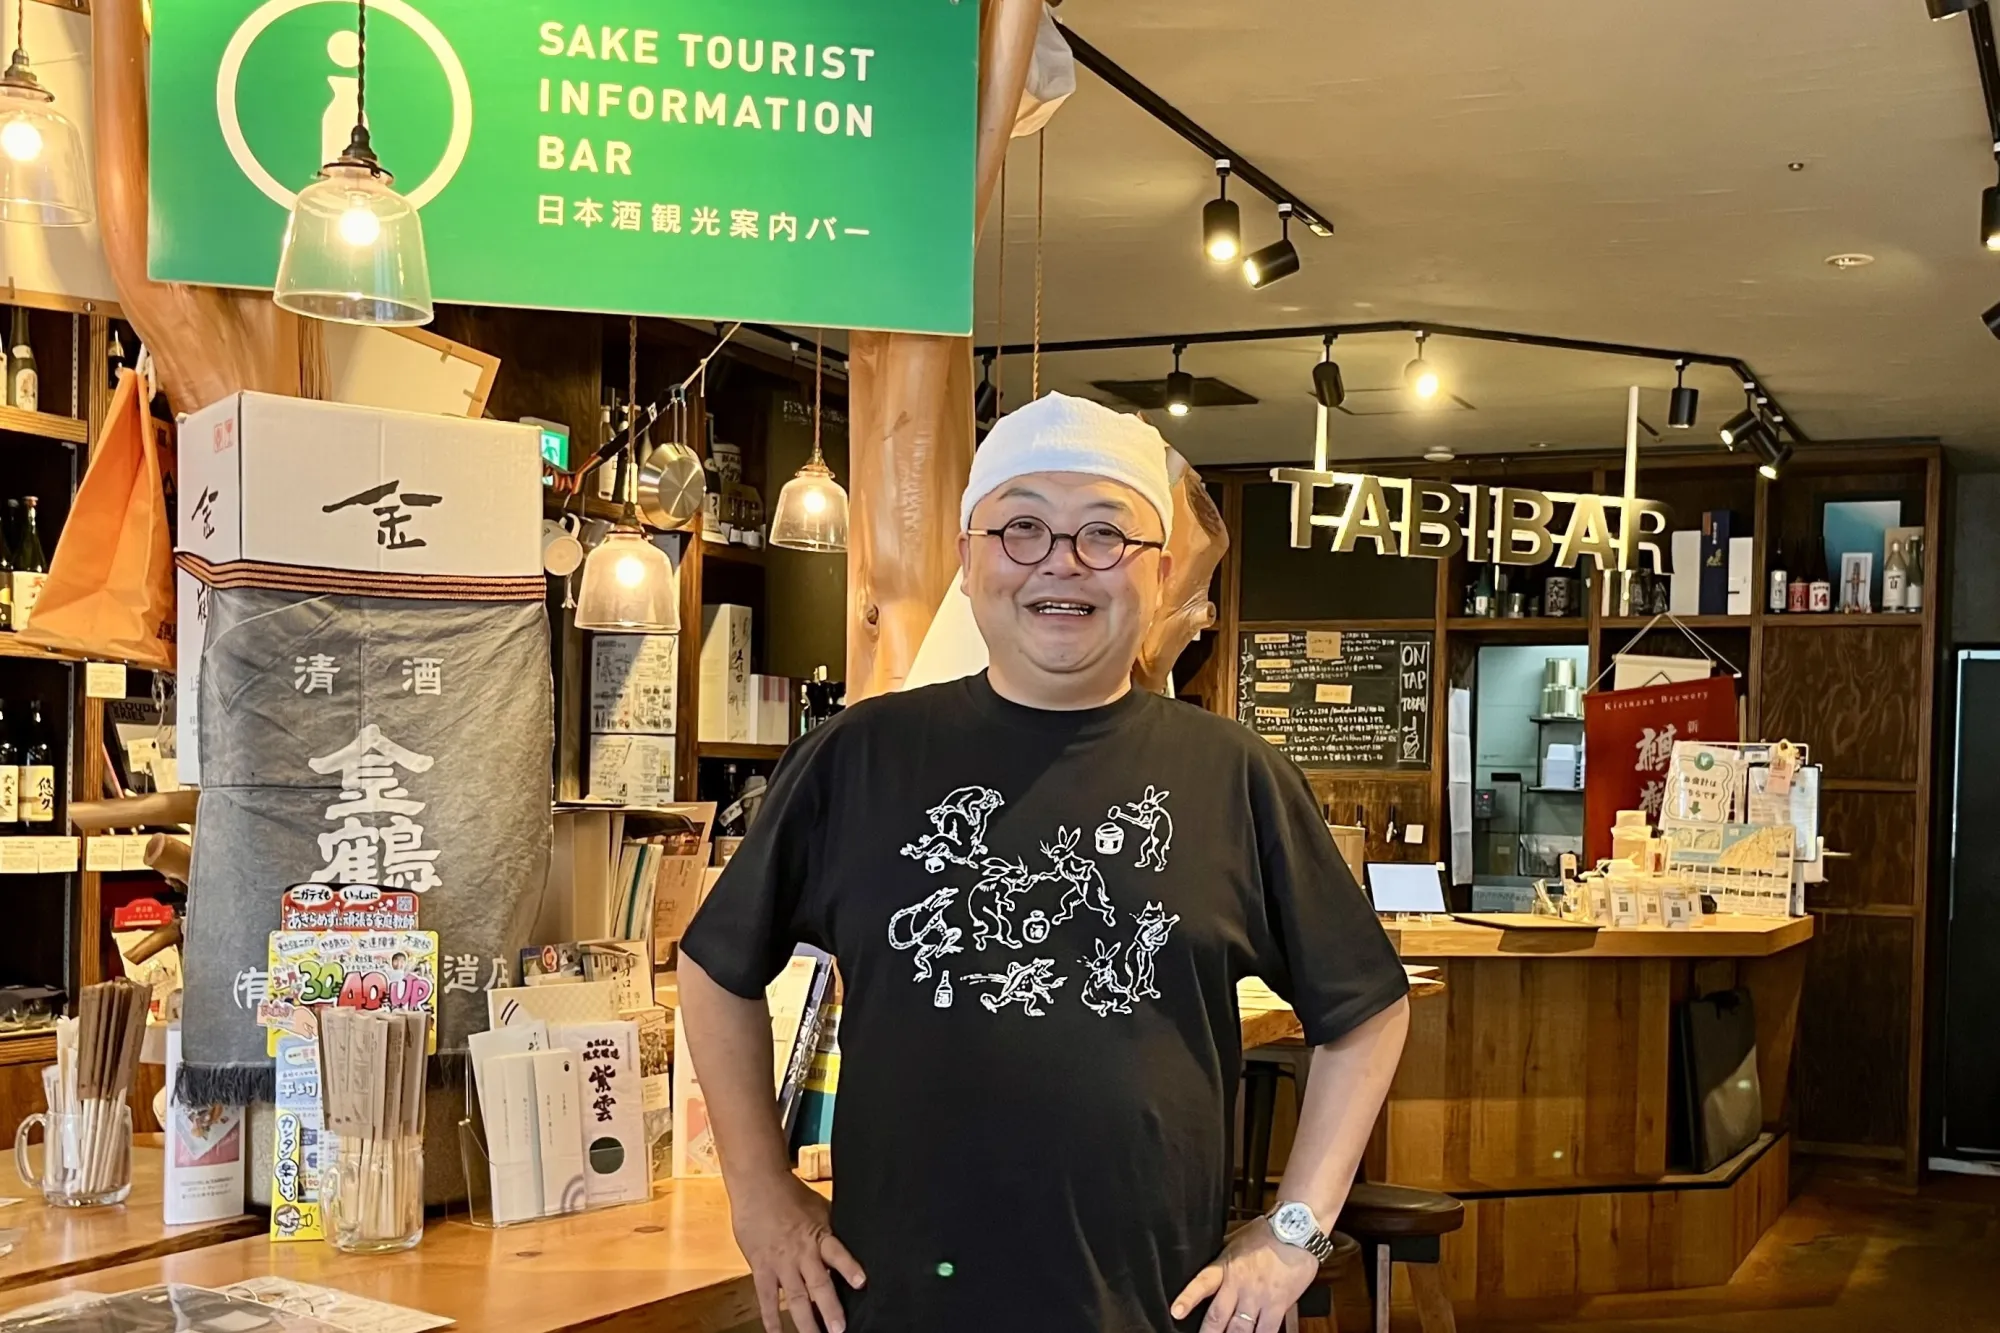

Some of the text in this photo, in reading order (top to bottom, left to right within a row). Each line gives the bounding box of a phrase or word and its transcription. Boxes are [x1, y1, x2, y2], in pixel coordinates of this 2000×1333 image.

[538, 21, 875, 82] SAKE TOURIST
[539, 78, 873, 138] INFORMATION
[537, 135, 632, 176] BAR
[537, 194, 870, 242] 日本酒観光案内バー
[321, 479, 444, 550] 金
[1270, 467, 1676, 575] TABIBAR
[1402, 645, 1426, 666] ON
[1402, 670, 1427, 690] TAP
[292, 888, 331, 900] ニガテでも
[588, 1063, 617, 1122] 紫雲
